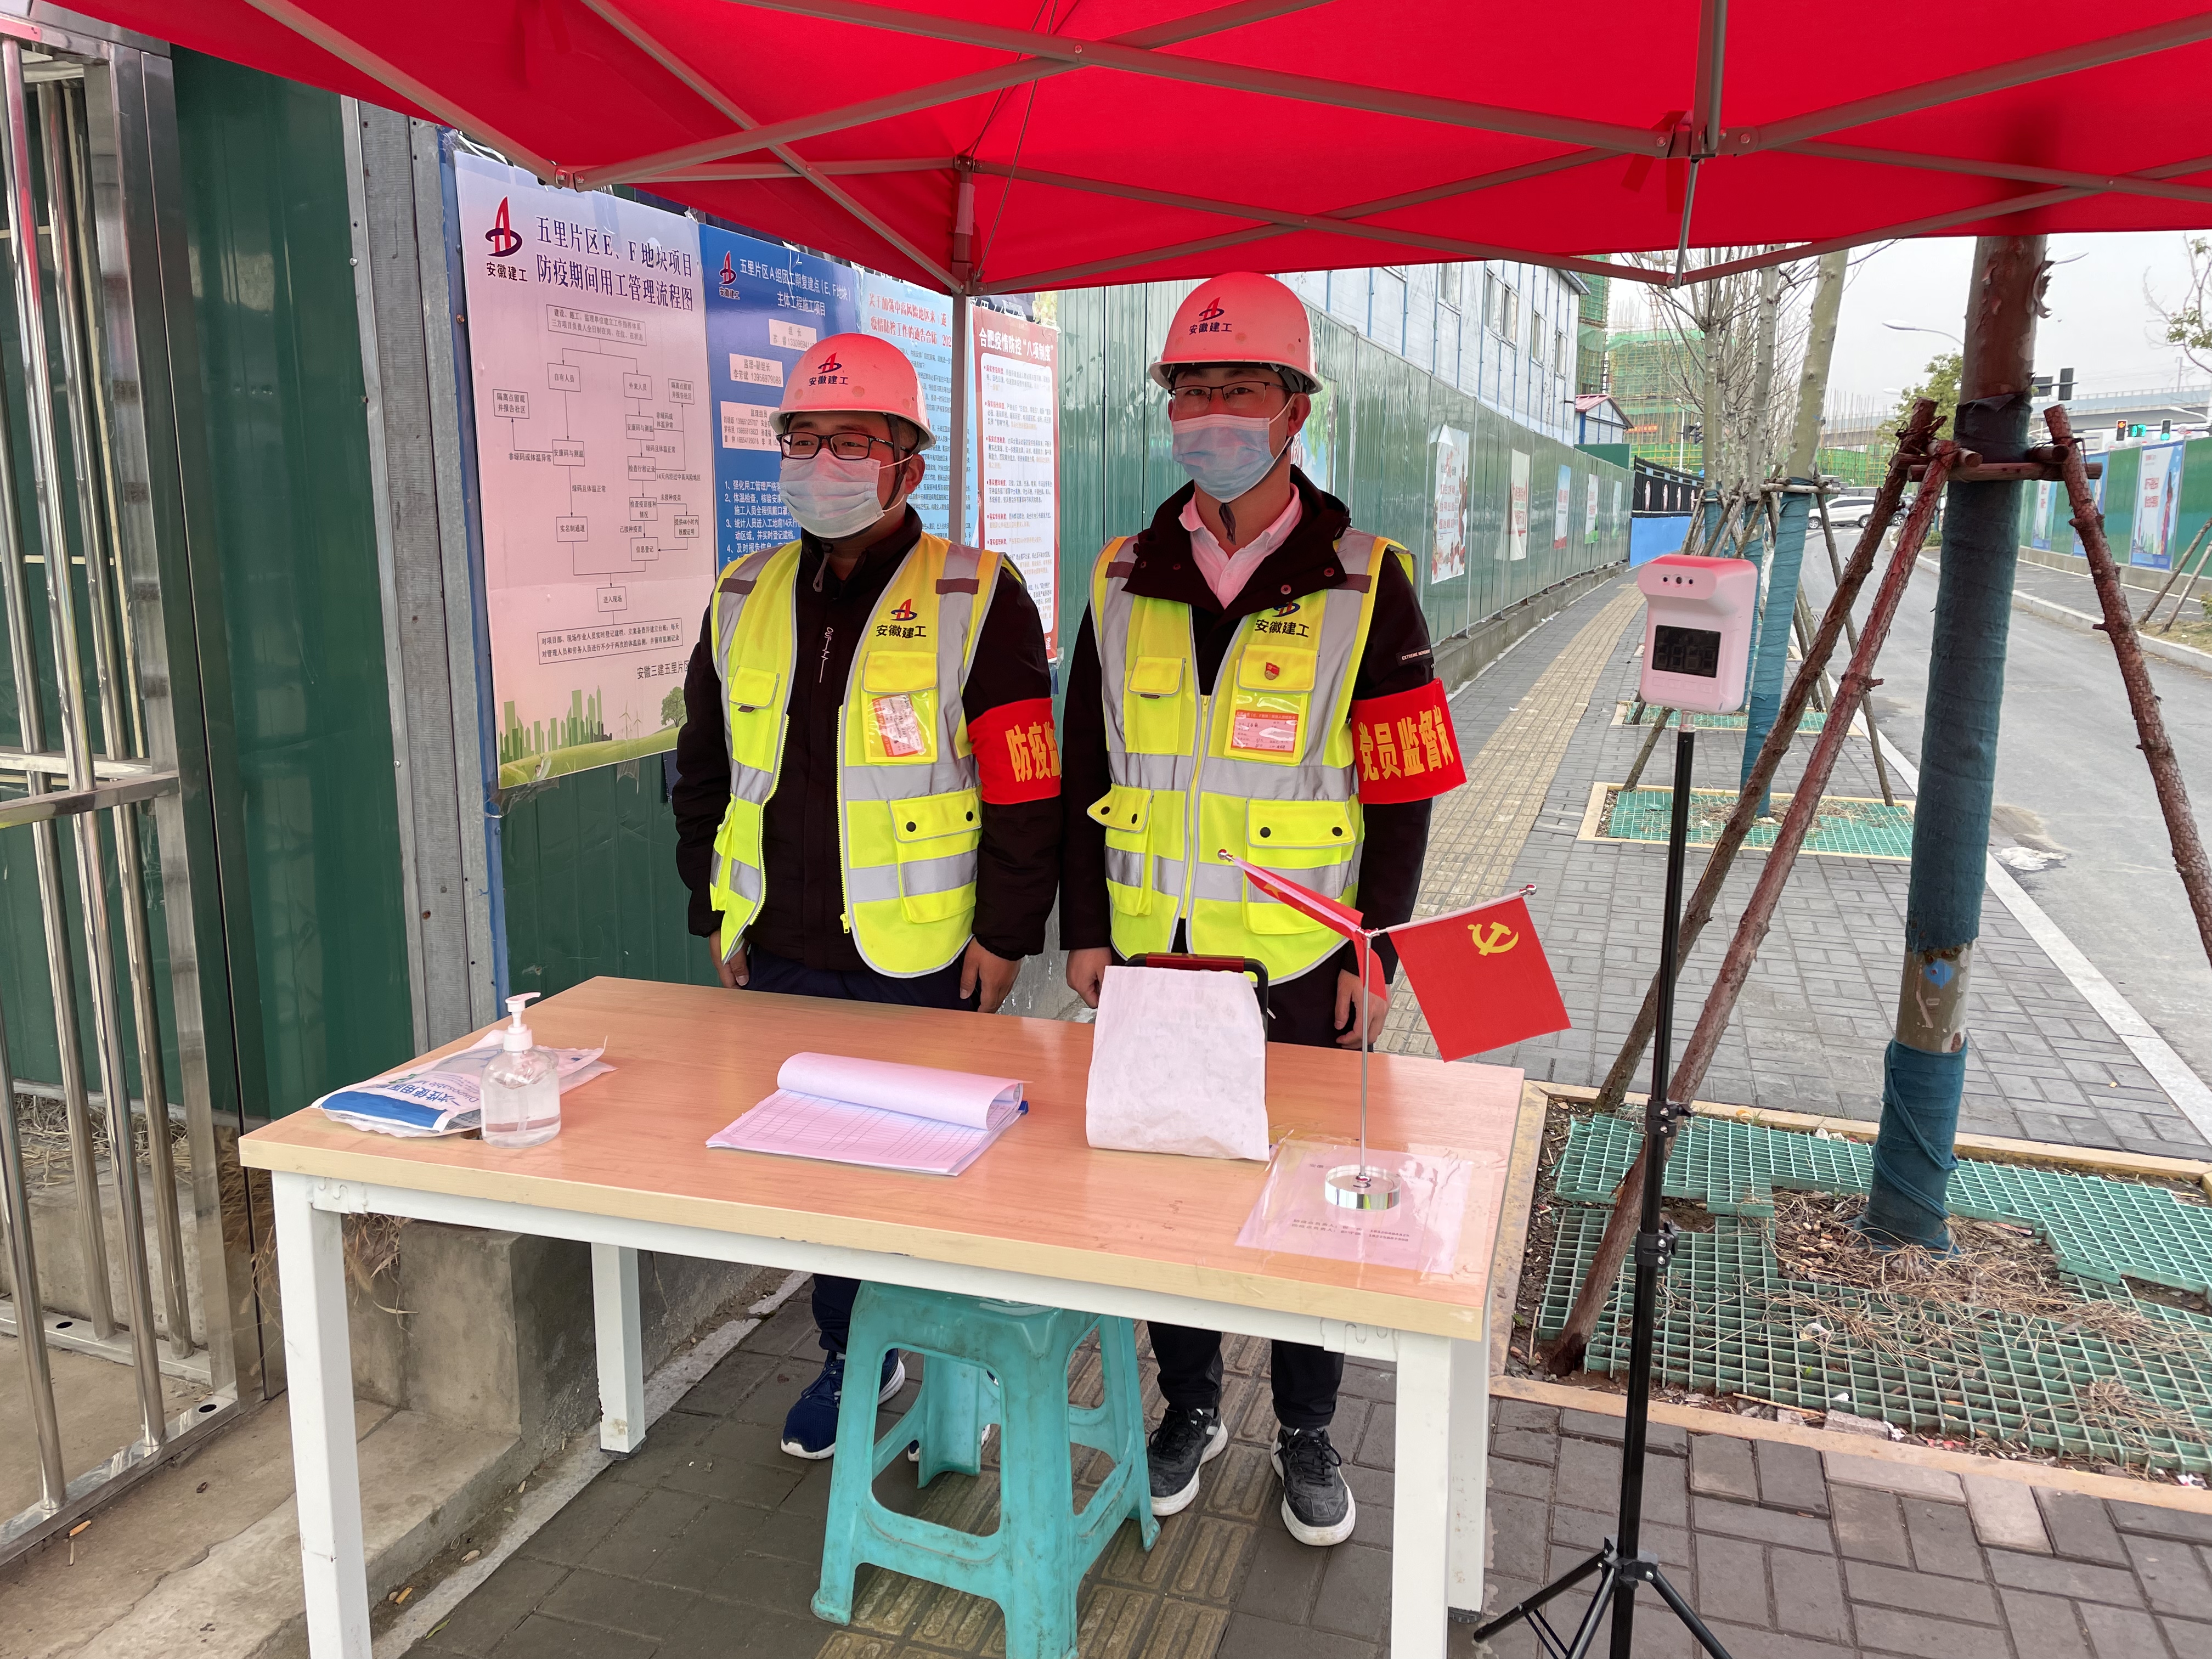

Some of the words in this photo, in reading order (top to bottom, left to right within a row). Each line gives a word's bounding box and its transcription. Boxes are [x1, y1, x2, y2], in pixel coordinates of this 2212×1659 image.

[535, 216, 693, 278] 五里片区E、F地块项目
[486, 261, 528, 283] 安徽建工
[536, 253, 693, 312] 防疫期间用工管理流程图
[719, 286, 741, 300] 安徽建工
[777, 291, 826, 317] 主体工程施工项目
[1189, 321, 1233, 335] 安徽建工
[554, 373, 575, 383] 自有人员
[809, 375, 849, 387] 安徽建工
[629, 381, 647, 391] 外来人员
[671, 381, 692, 391] 隔离点留观
[496, 392, 526, 403] 隔离点留观
[672, 391, 692, 400] 并报告社区
[498, 403, 526, 414] 并报告社区
[627, 424, 654, 433] 安康码与测温
[656, 421, 674, 429] 体温异常
[553, 449, 584, 458] 安康码与测温
[646, 444, 676, 453] 绿码且体温正常
[508, 452, 551, 462] 非绿码或体温异常
[628, 464, 656, 473] 检查行程记录
[572, 483, 606, 494] 绿码且体温正常
[630, 500, 657, 508] 检查疫苗接种
[560, 524, 585, 534] 实名制通道
[619, 525, 642, 533] 已接种疫苗
[636, 545, 654, 554] 信息登记
[603, 595, 622, 604] 进入现场
[876, 624, 927, 639] 安徽建工
[1254, 618, 1310, 638] 安徽建工
[428, 1081, 479, 1103] Disposable
